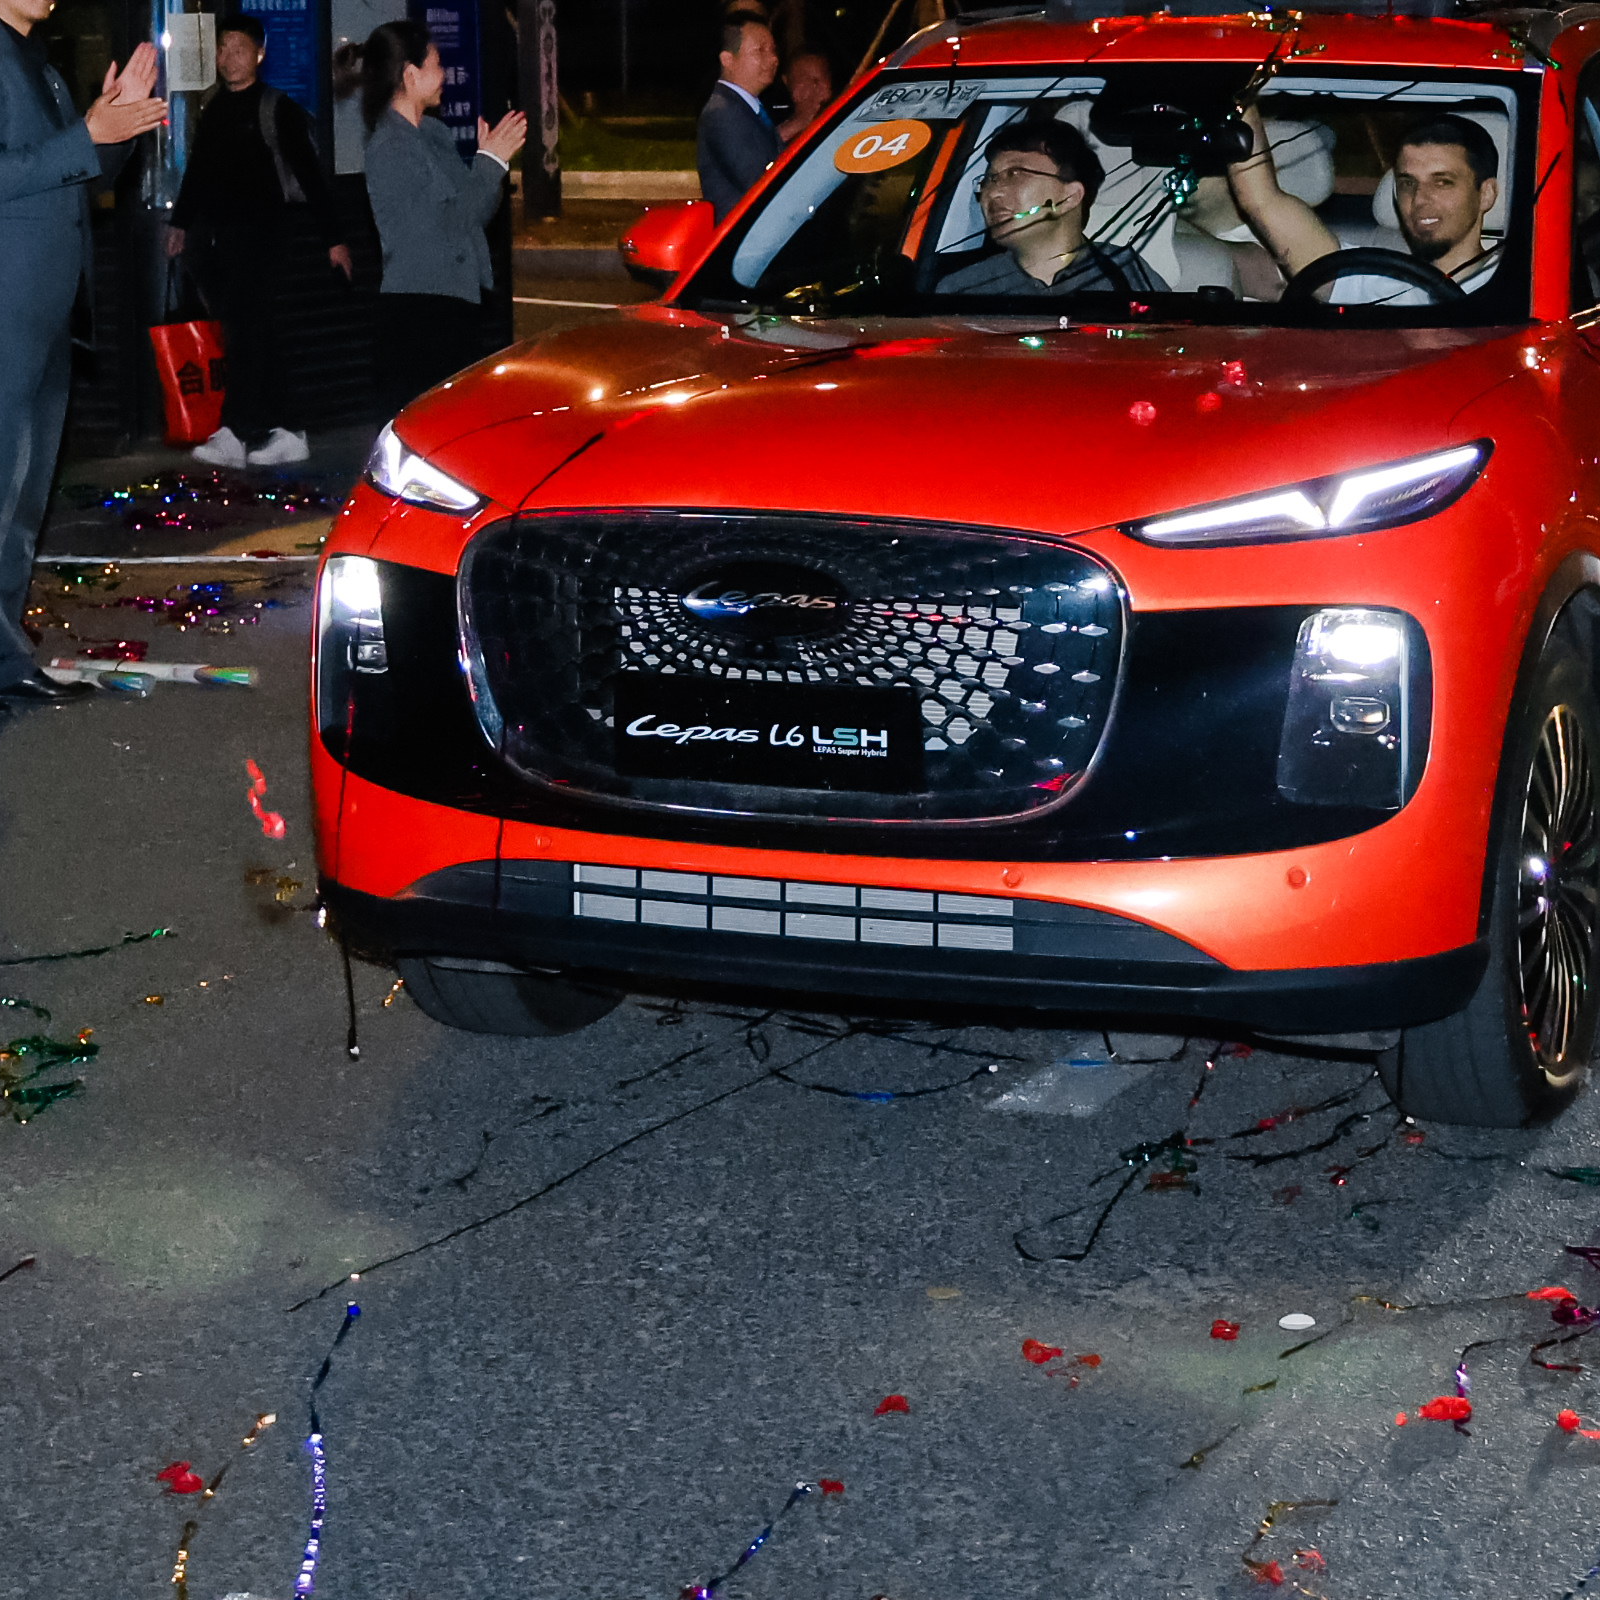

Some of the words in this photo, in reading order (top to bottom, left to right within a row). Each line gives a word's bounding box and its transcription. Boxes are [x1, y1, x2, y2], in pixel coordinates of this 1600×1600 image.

[852, 132, 911, 160] 04
[625, 714, 760, 745] Lepas
[769, 723, 805, 747] L6
[811, 725, 888, 748] LSH
[812, 745, 837, 754] LEPAS
[837, 746, 860, 757] Super
[860, 747, 888, 758] Hybrid
